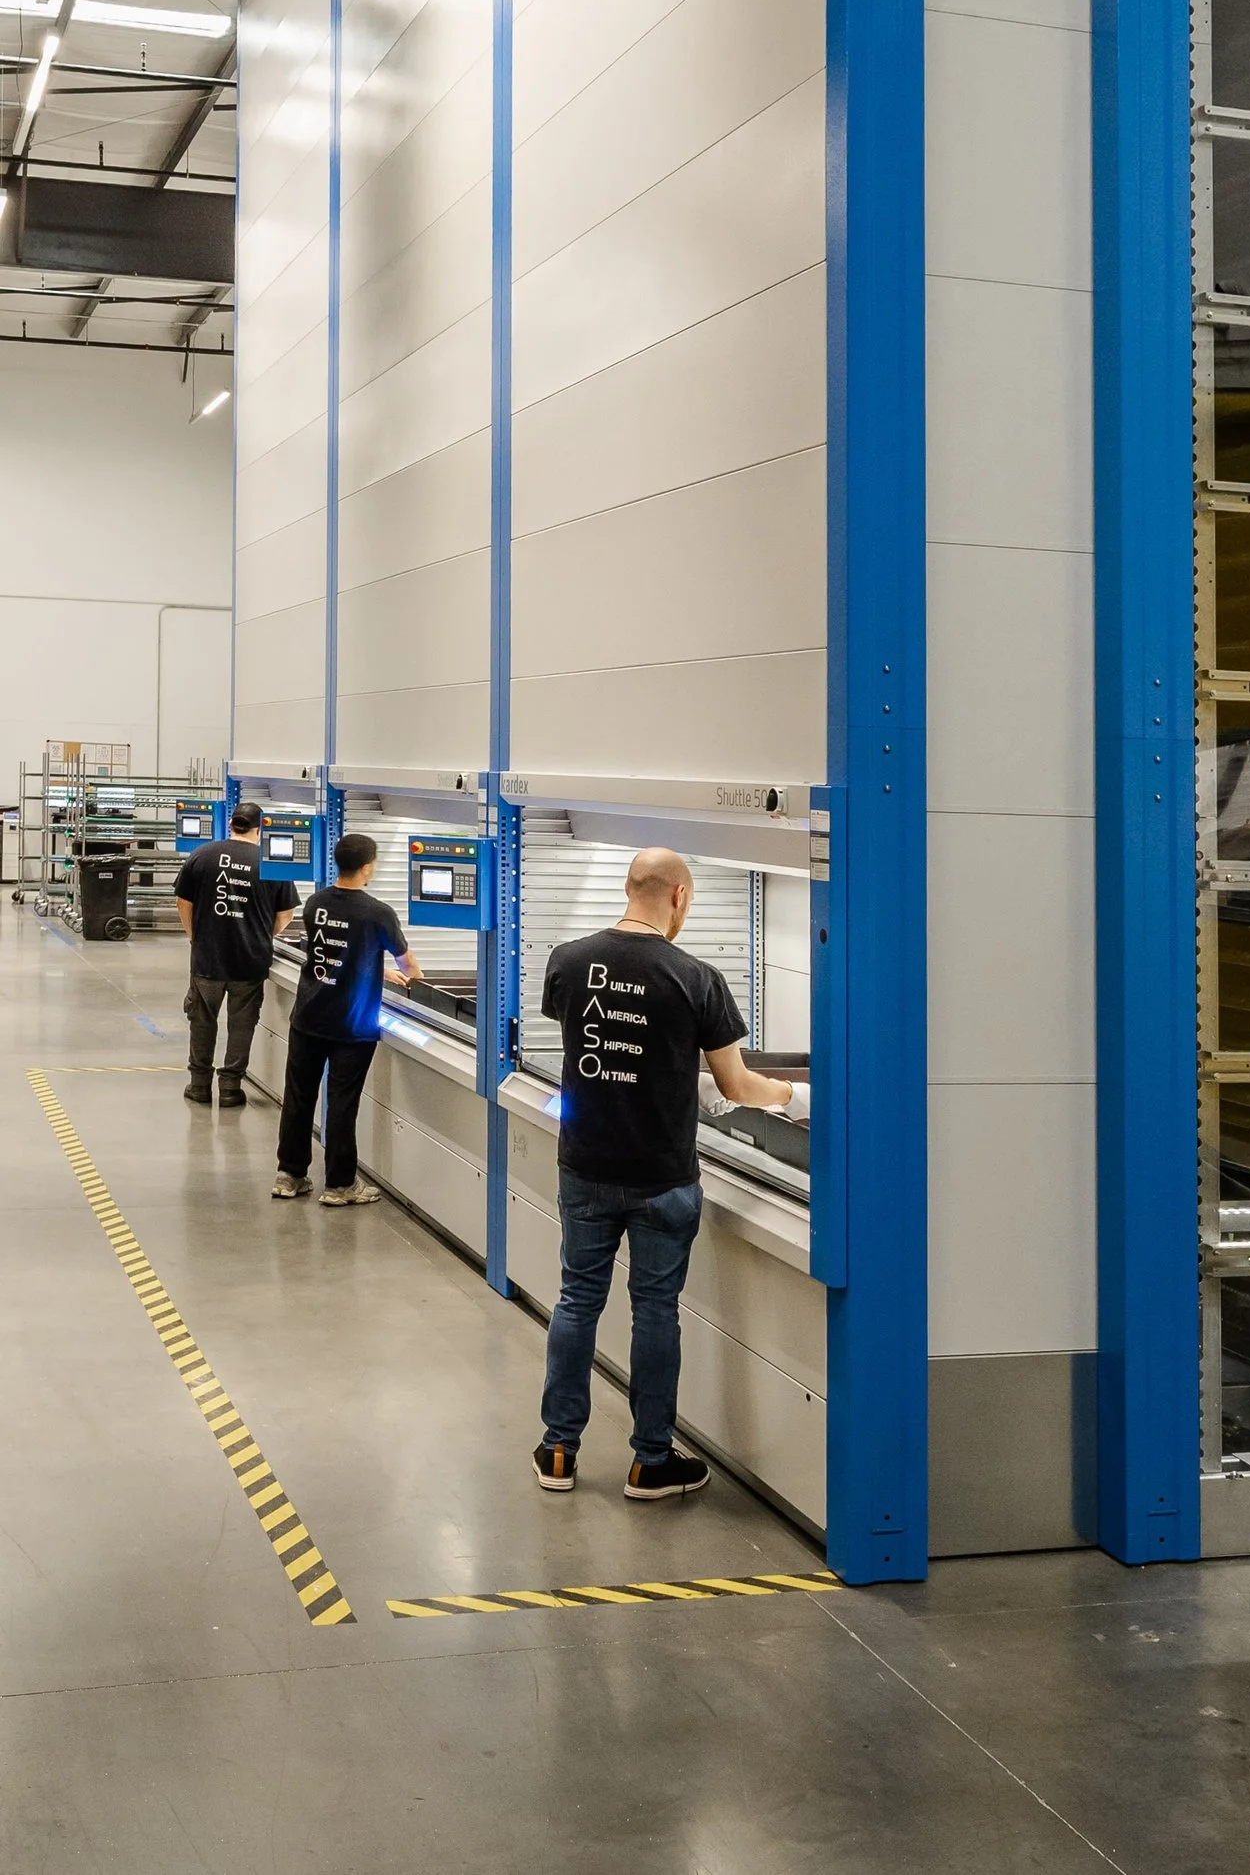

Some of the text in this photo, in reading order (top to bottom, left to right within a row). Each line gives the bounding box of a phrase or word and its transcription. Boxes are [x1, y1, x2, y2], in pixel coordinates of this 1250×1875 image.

[501, 773, 529, 794] kardex
[716, 786, 752, 808] Shuttle
[611, 1071, 638, 1083] TIME
